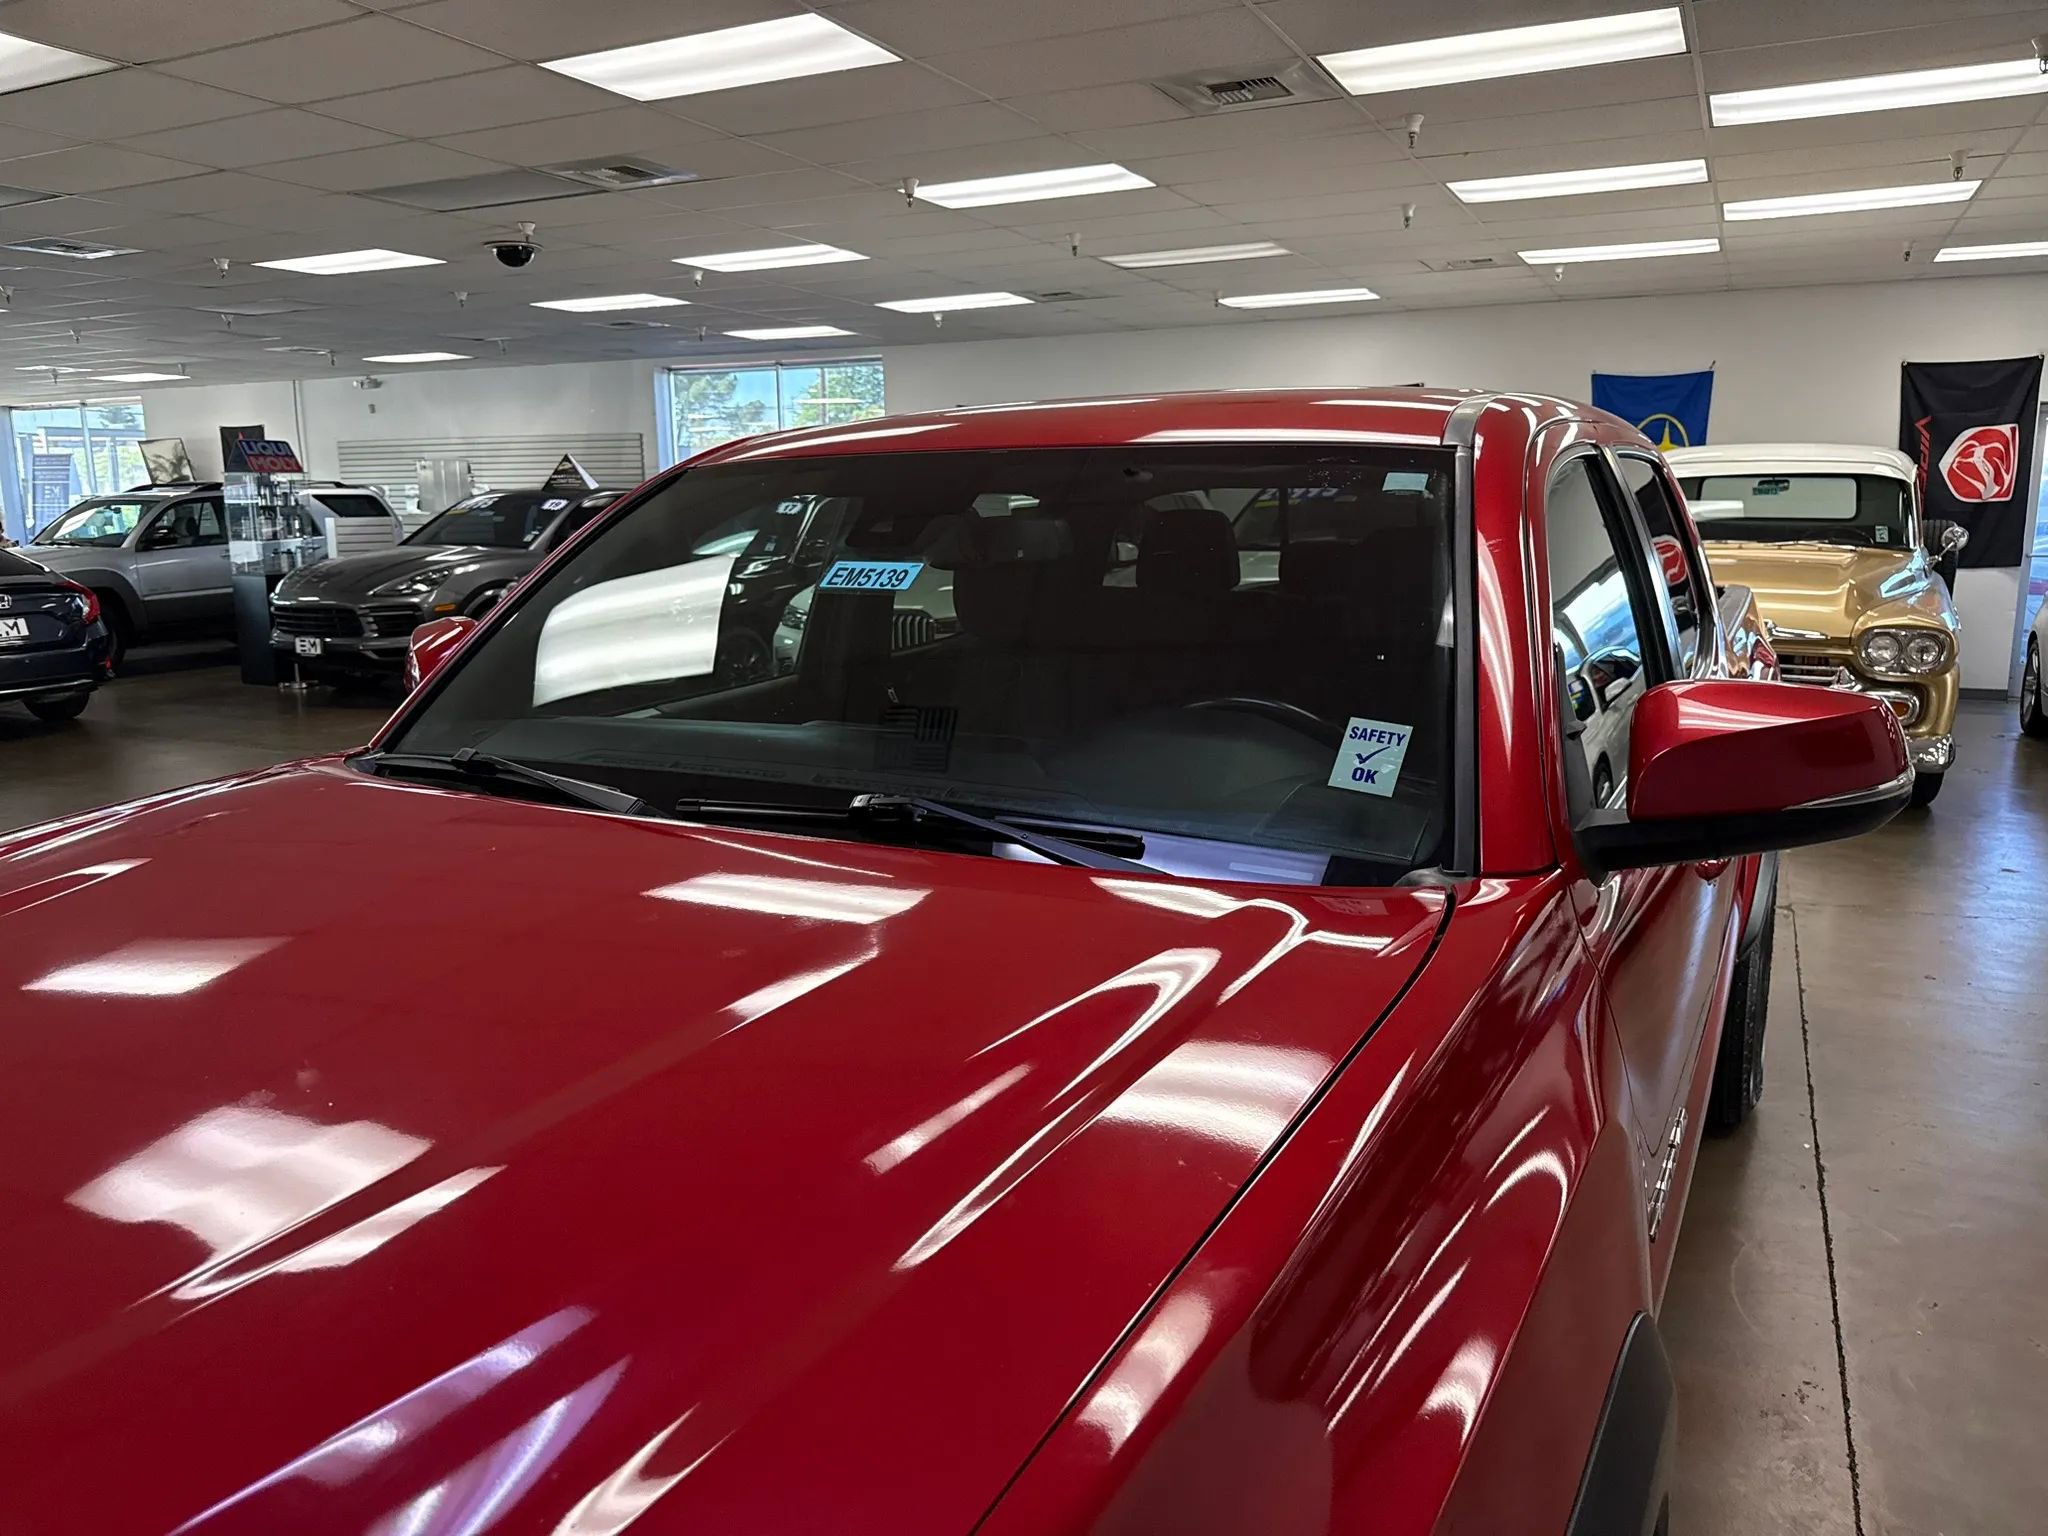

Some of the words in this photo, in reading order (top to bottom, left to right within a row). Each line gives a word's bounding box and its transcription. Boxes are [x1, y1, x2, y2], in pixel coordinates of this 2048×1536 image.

[241, 441, 292, 456] LIQUI
[247, 456, 300, 471] MOLY
[825, 567, 909, 588] EM5139
[0, 620, 21, 636] M
[299, 639, 318, 653] EM
[1349, 726, 1406, 746] SAFETY
[1351, 767, 1379, 784] OK
